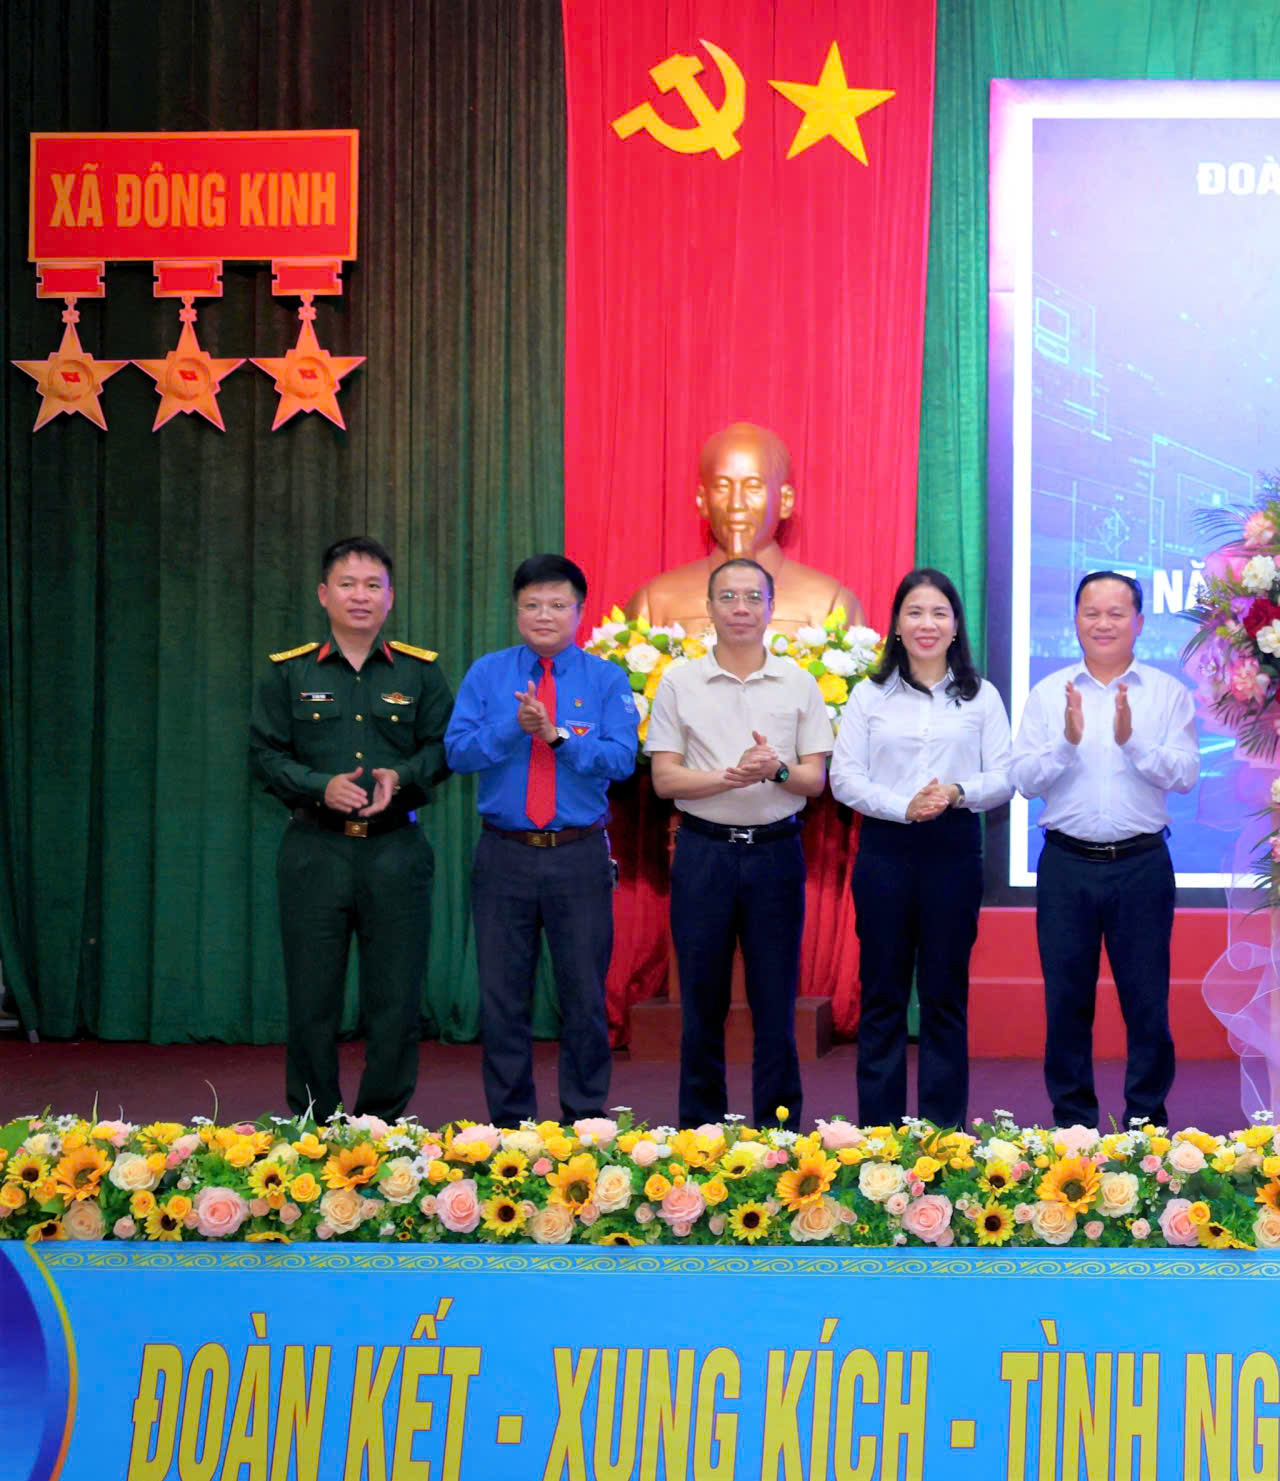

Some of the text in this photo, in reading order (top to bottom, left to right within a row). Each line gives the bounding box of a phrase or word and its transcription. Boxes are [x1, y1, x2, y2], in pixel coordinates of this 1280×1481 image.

[50, 161, 337, 227] XÃ ĐÔNG KINH
[1153, 559, 1213, 614] NĂ
[127, 1313, 331, 1481] ĐOÀN
[344, 1298, 482, 1481] KẾT
[543, 1347, 742, 1481] XUNG
[764, 1317, 930, 1481] KÍCH
[1001, 1319, 1158, 1481] TÌNH
